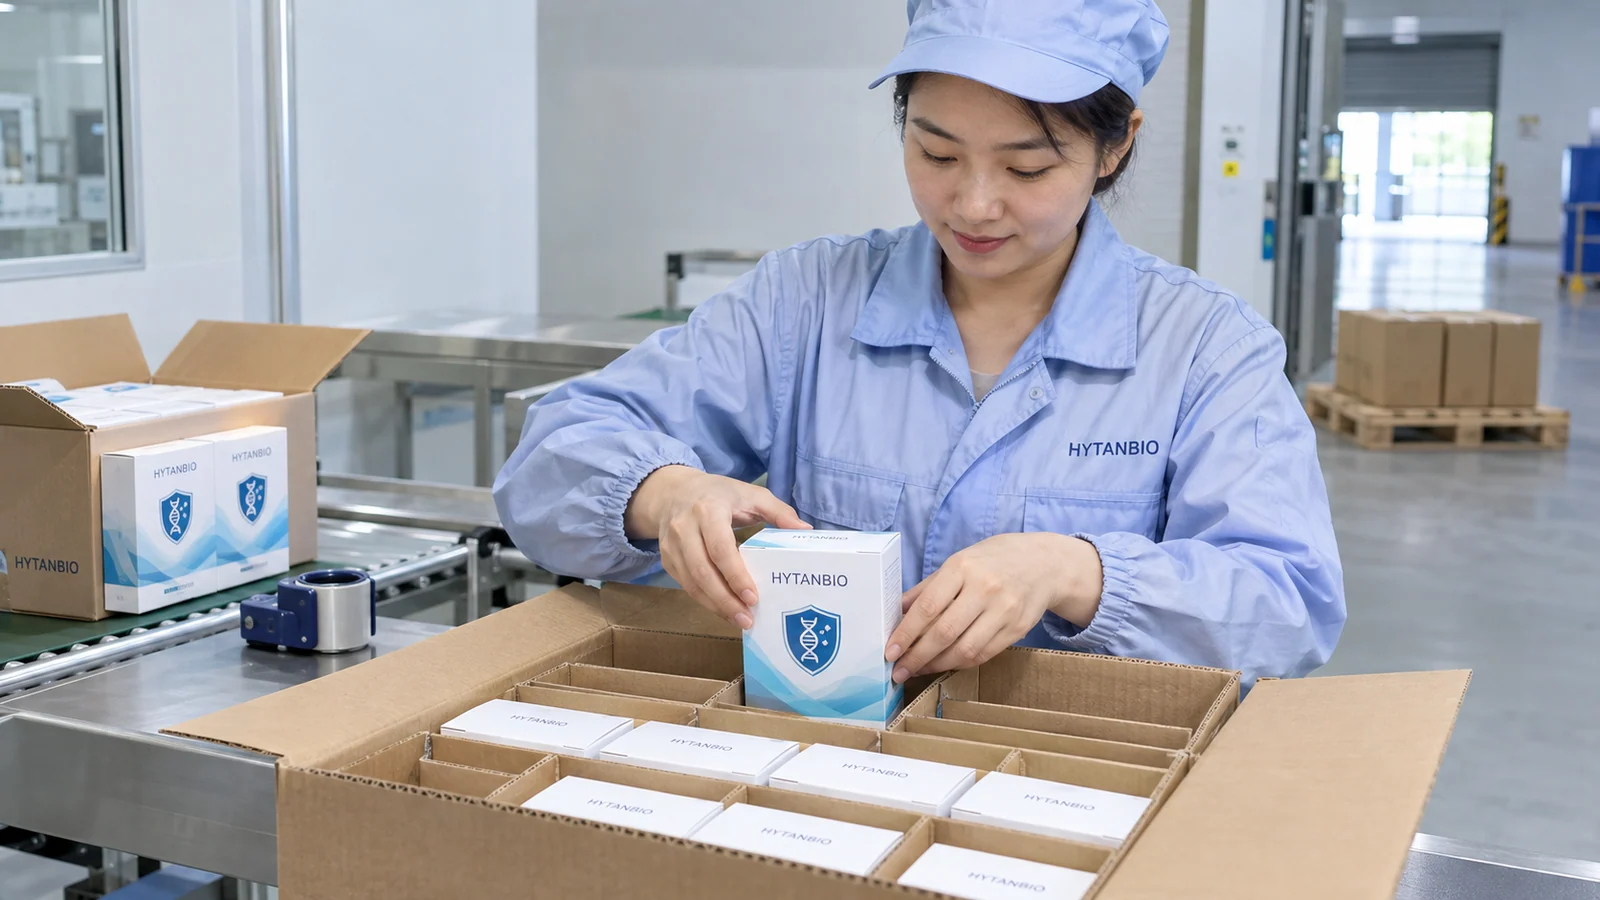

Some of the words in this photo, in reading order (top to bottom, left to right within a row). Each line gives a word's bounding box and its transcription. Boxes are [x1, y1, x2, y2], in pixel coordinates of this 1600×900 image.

[232, 446, 272, 463] HYTANBIO
[1068, 440, 1160, 457] HYTANBIO
[153, 461, 197, 479] HYTANBIO
[15, 556, 79, 575] HYTANBIO
[772, 572, 848, 587] HYTANBIO
[511, 714, 567, 727] HYTANBIO
[671, 737, 733, 752] HYTANBIO
[842, 763, 908, 778] HYTANBIO
[588, 798, 654, 815] HYTANBIO
[1023, 793, 1095, 812] HYTANBIO
[761, 827, 833, 846] HYTANBIO
[967, 871, 1046, 893] HYTANBIO
